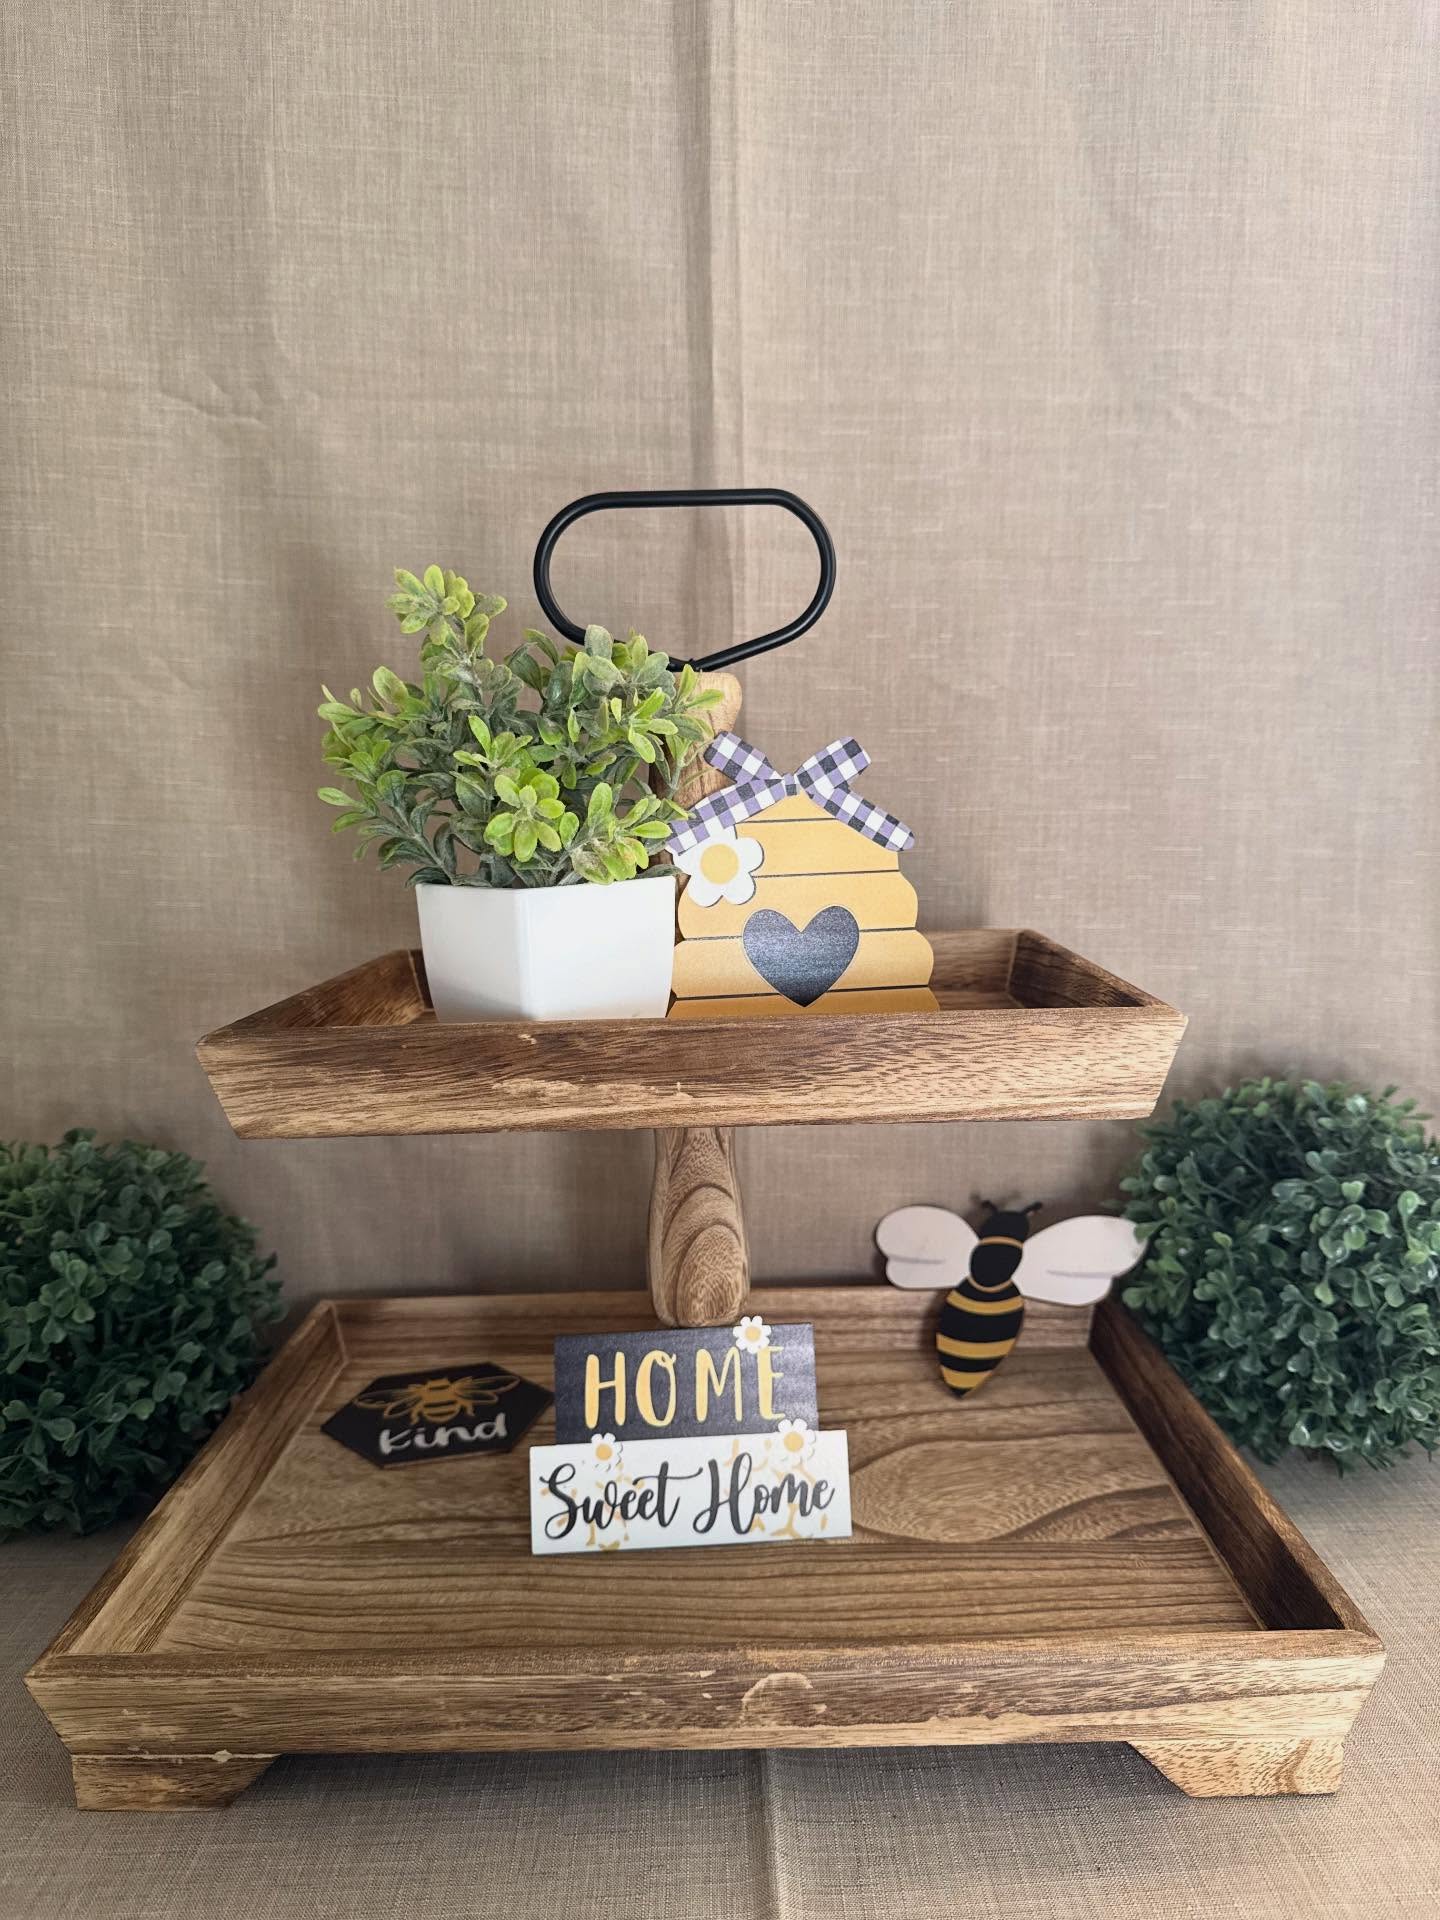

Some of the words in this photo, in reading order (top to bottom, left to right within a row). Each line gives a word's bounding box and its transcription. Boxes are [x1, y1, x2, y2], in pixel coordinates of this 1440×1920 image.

[584, 1346, 786, 1428] HOME
[539, 1461, 703, 1540] Sweet
[692, 1452, 835, 1535] Home
